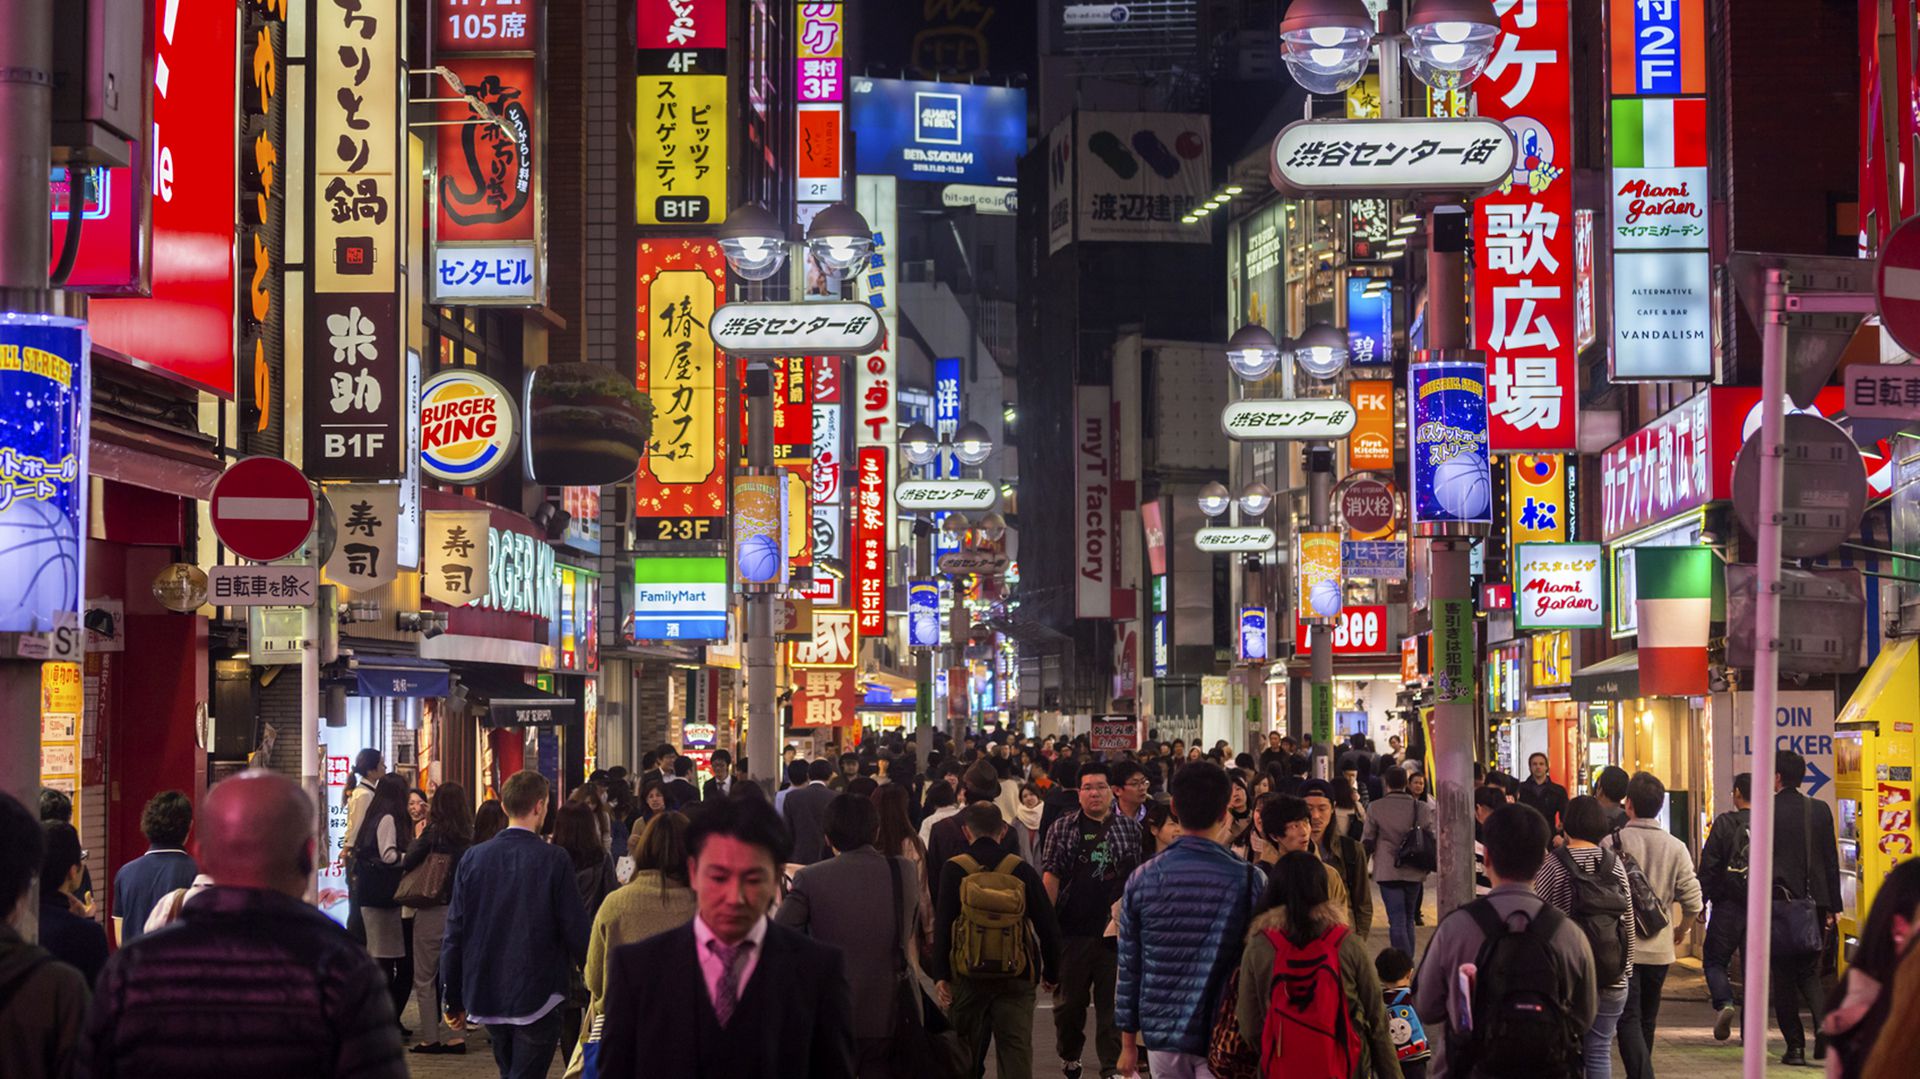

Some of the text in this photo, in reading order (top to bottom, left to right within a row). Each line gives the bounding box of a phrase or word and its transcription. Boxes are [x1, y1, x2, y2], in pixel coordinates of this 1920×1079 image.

[449, 12, 527, 39] 105席
[667, 52, 697, 72] 4F
[803, 60, 836, 77] 受付
[803, 78, 837, 98] 3F
[921, 108, 956, 120] ALWAYS
[656, 81, 676, 192] スパゲッティ
[690, 104, 710, 180] ピッツァ
[1286, 138, 1502, 168] 渋谷センター街
[811, 185, 827, 195] 2F
[1617, 178, 1690, 198] Miami
[663, 200, 701, 217] B1F
[945, 192, 1005, 206] hit-ad.co.jp
[1617, 224, 1704, 238] マイアミガーデン
[439, 259, 533, 286] センタービル
[720, 316, 872, 336] 渋谷センター街
[1484, 202, 1562, 431] 歌広場
[1621, 329, 1704, 340] VANDALISM
[1353, 336, 1375, 362] 碧
[326, 306, 382, 413] 米助
[659, 295, 705, 460] 椿屋カフェ
[421, 397, 495, 426] BURGER
[1357, 394, 1386, 411] FK
[1230, 410, 1349, 427] 渋谷センター街
[421, 414, 497, 450] KING
[324, 434, 385, 458] B1F
[1354, 446, 1389, 455] Kitchen
[1360, 440, 1382, 448] First
[1605, 398, 1707, 537] カラオケ歌広場
[901, 488, 990, 501] 渋谷センター街
[1346, 497, 1390, 518] 消火栓
[1519, 497, 1558, 531] 松
[345, 500, 382, 578] 寿司
[1081, 484, 1108, 583] factory
[1199, 533, 1271, 545] 渋谷センター街
[442, 525, 475, 594] 寿司
[1523, 559, 1597, 572] パスタとピザ
[215, 575, 311, 597] 自転車を除く
[862, 579, 880, 591] 2F
[1523, 578, 1583, 593] Miami
[640, 590, 706, 604] FamilyMart
[862, 597, 880, 609] 3F
[1486, 587, 1506, 607] 1F
[666, 622, 680, 637] 酒
[862, 615, 880, 626] 4F
[805, 671, 842, 725] 野郎
[1744, 735, 1832, 755] LCKER
